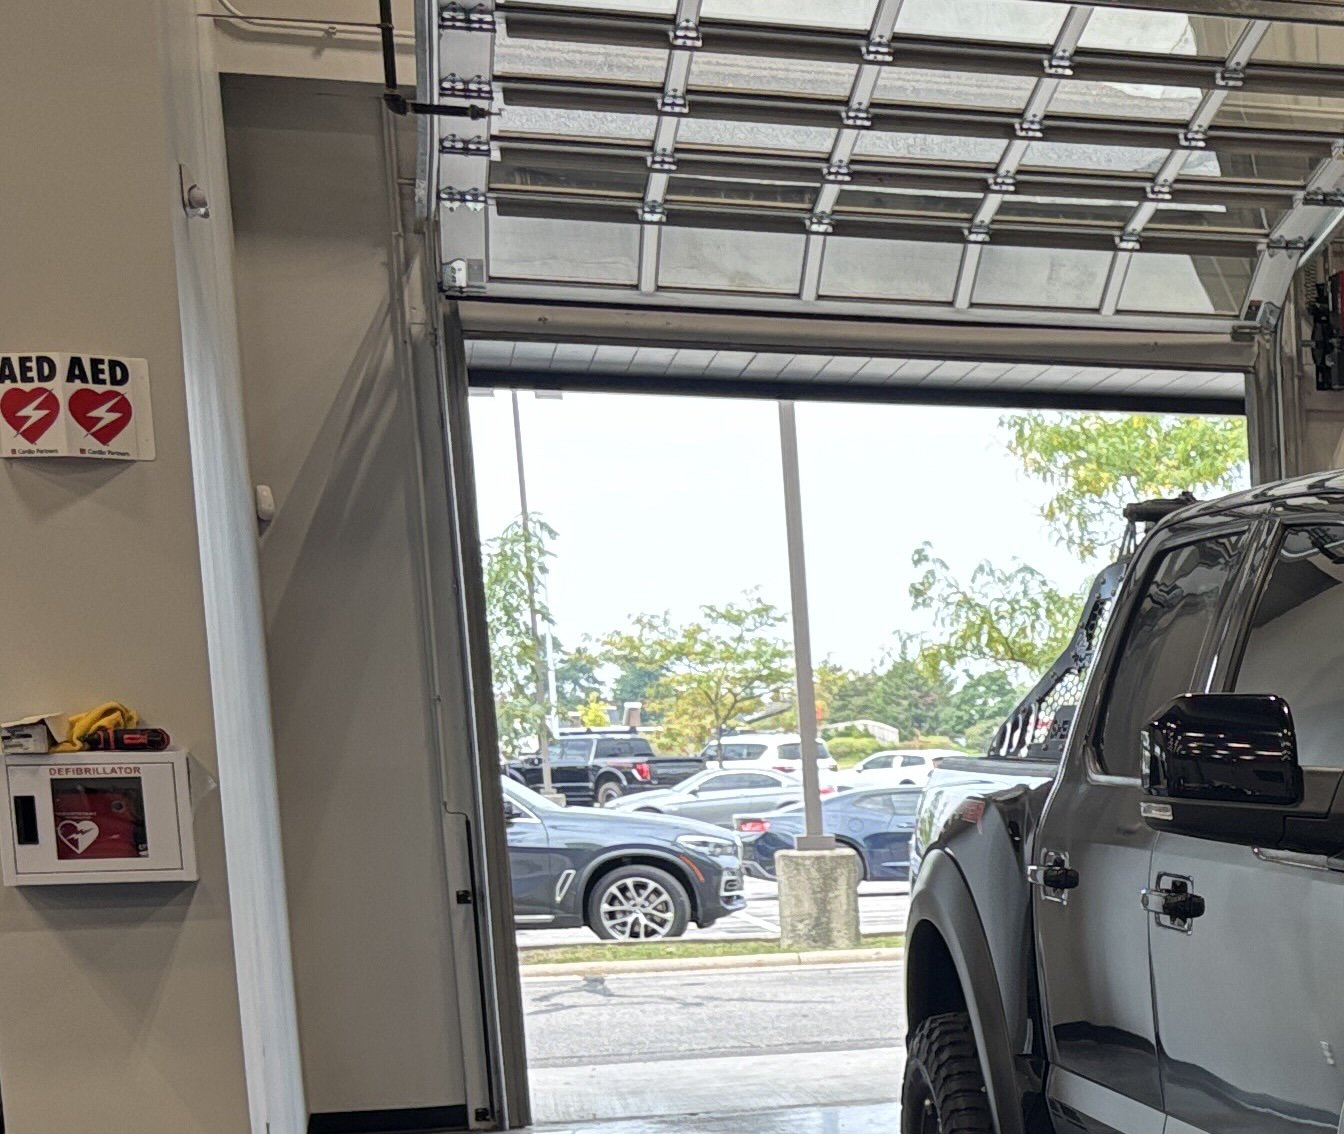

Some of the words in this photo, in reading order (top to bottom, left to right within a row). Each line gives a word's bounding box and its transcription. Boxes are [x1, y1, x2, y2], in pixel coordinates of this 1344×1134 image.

[0, 355, 57, 383] AED
[66, 356, 129, 386] AED
[49, 766, 142, 776] DEFIBRILLATOR
